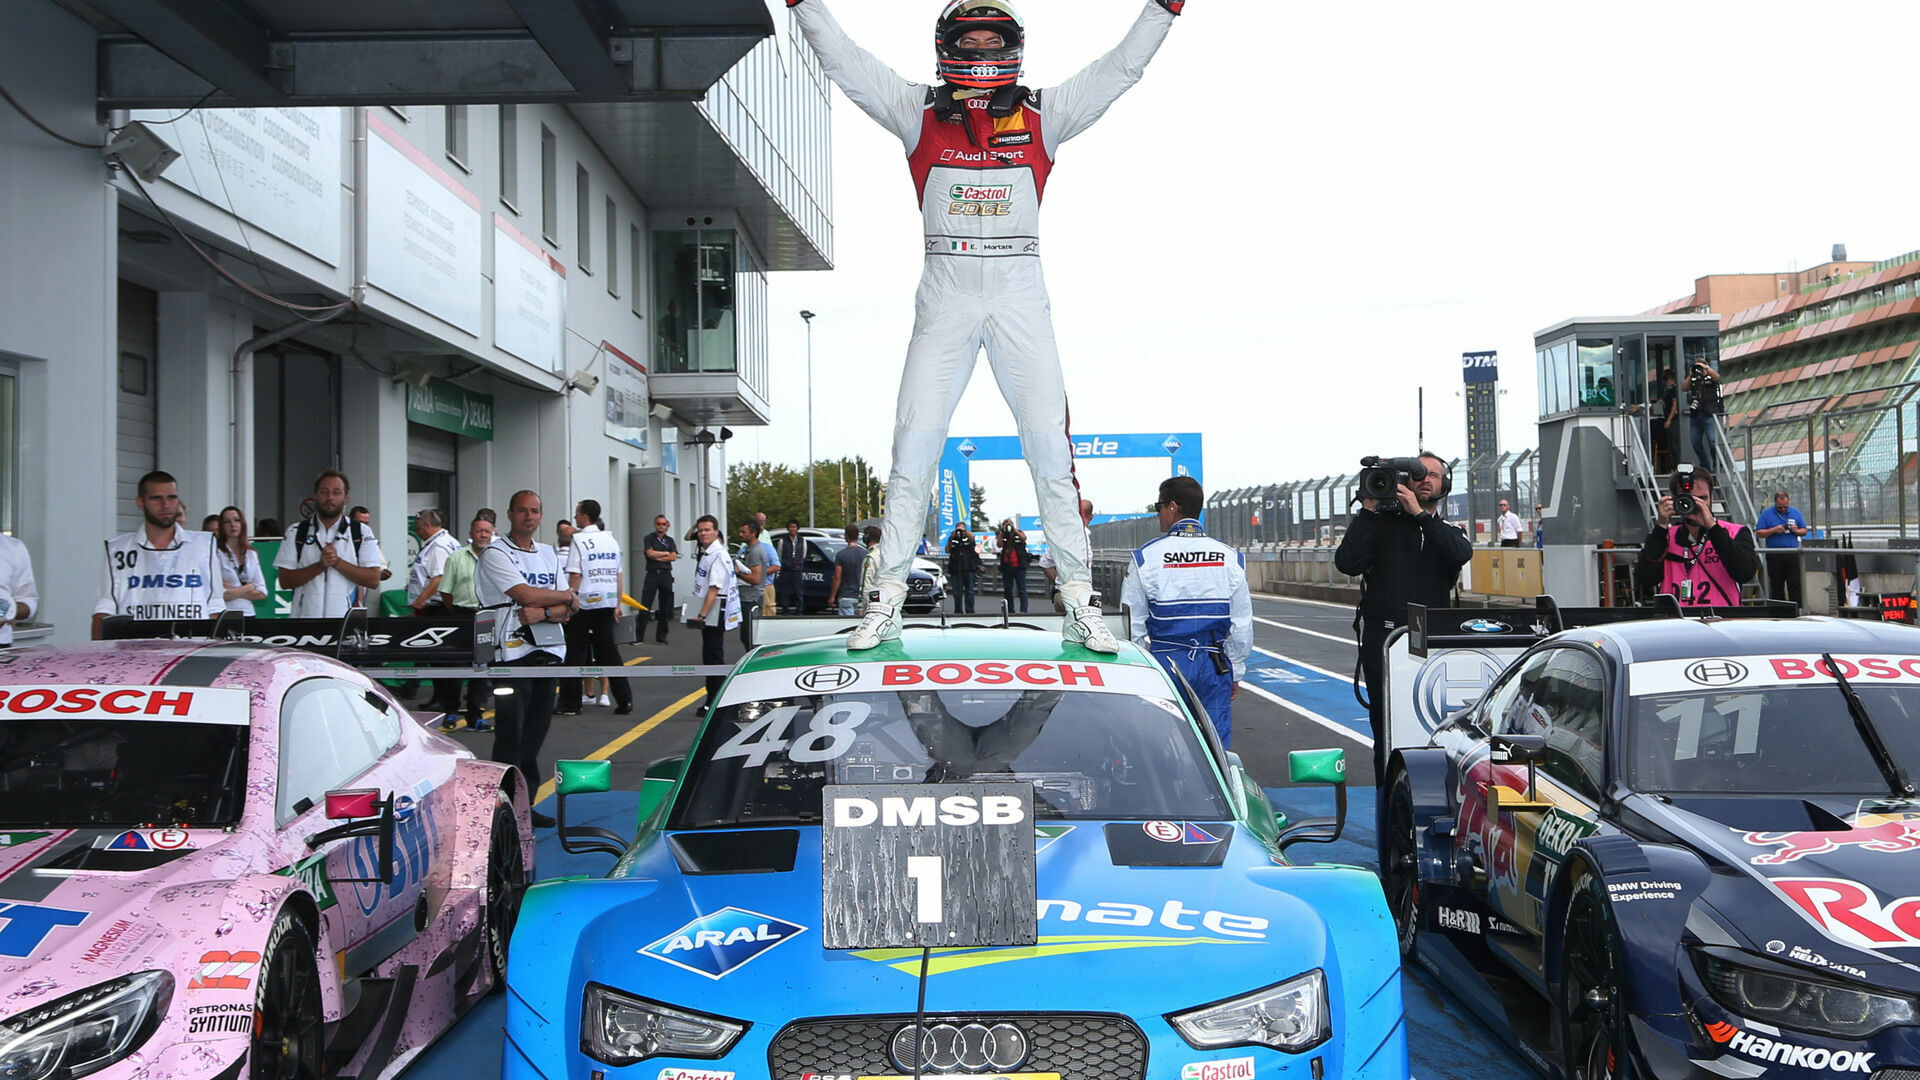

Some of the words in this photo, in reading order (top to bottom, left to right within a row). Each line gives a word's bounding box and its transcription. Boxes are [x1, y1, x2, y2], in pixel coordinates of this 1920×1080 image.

[955, 151, 986, 161] Audi
[964, 187, 1007, 200] Castrol
[949, 202, 1013, 216] EDGE
[1463, 355, 1497, 368] DTM
[940, 468, 953, 526] ultimate
[114, 550, 138, 570] 30
[588, 552, 617, 562] DMSB
[1163, 551, 1226, 563] SANDTLER
[127, 574, 203, 590] DMSB
[802, 572, 825, 581] NTROL
[126, 604, 202, 620] SRUTINEER
[882, 663, 1106, 687] BOSCH
[712, 701, 872, 769] 48
[1656, 694, 1763, 760] 11
[833, 795, 1025, 828] DMSB
[907, 855, 943, 924] 1
[1608, 882, 1638, 892] BMW
[1640, 881, 1682, 890] Driving
[1610, 891, 1675, 902] Experience
[1037, 899, 1270, 938] mate
[81, 919, 135, 963] MAGNESIUM
[661, 923, 782, 955] ARAL
[1788, 949, 1829, 967] HELIX
[187, 950, 262, 989] 22
[189, 1003, 253, 1016] PETRONAS
[189, 1015, 252, 1034] SYNTIUM
[1201, 1060, 1252, 1080] Castrol
